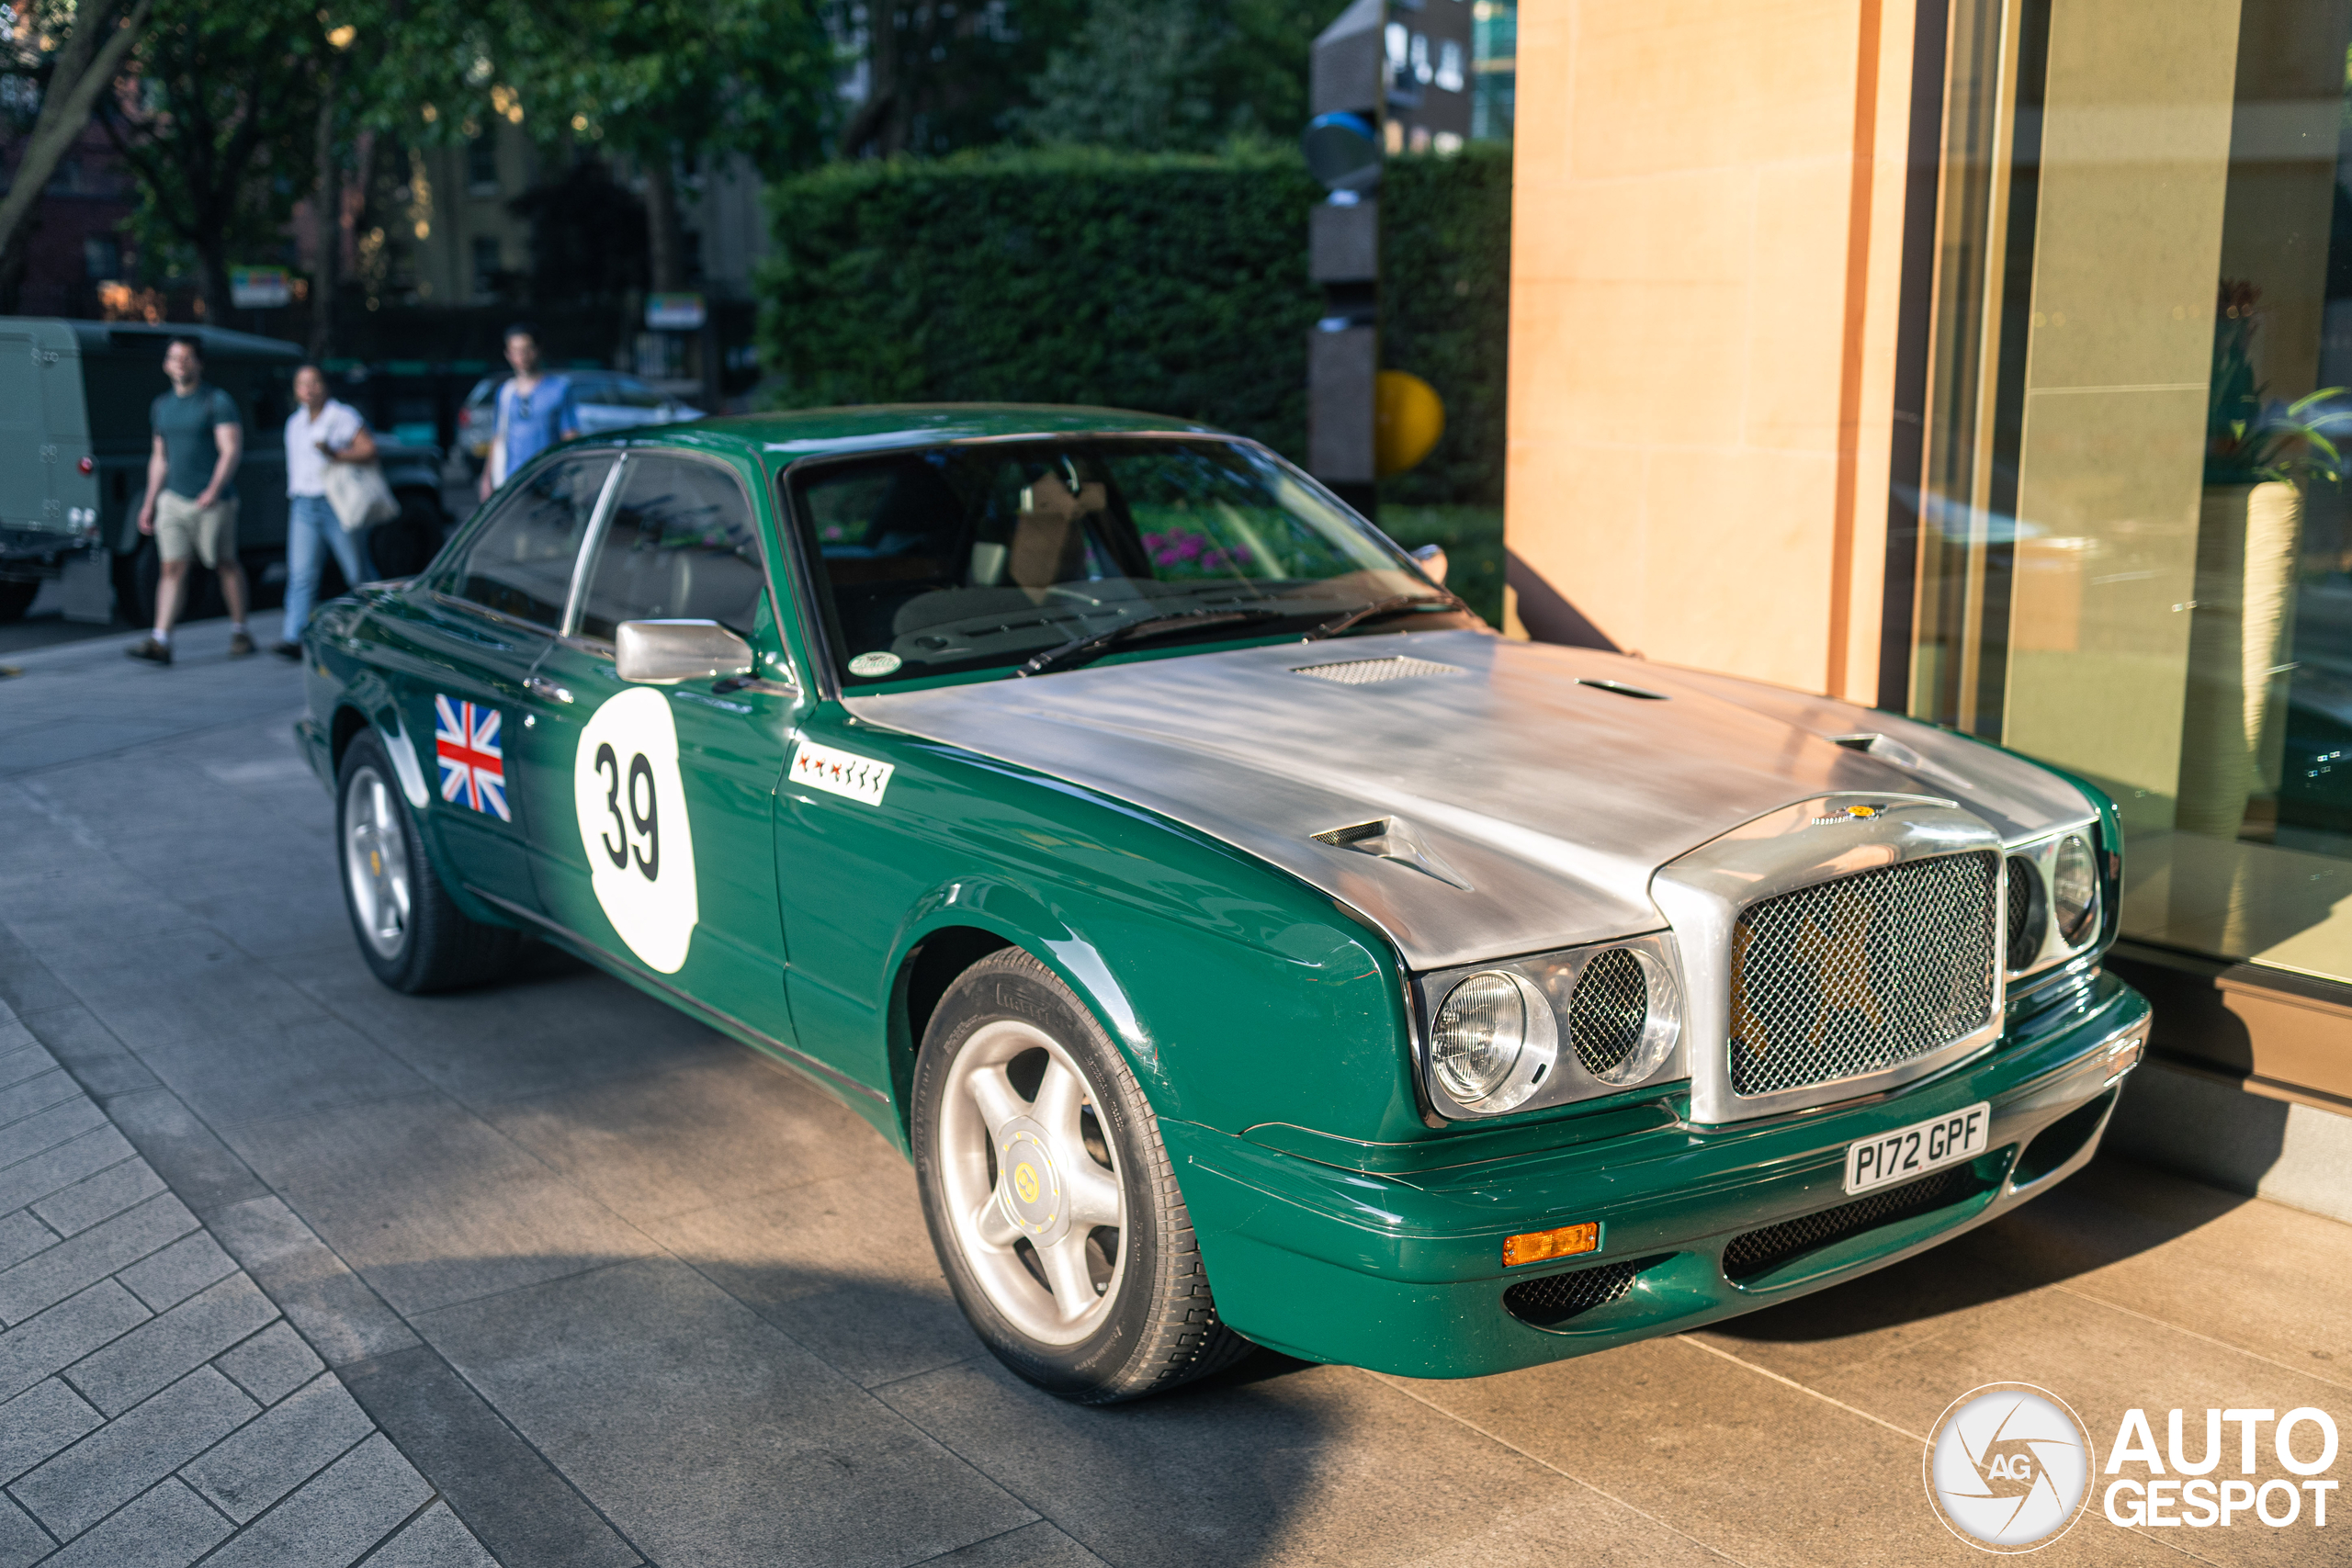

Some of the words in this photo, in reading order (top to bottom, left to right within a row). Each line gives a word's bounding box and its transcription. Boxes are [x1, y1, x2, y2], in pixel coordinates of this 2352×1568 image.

[594, 742, 660, 883] 39
[1855, 1132, 1921, 1185] P172
[1928, 1111, 1983, 1161] GPF
